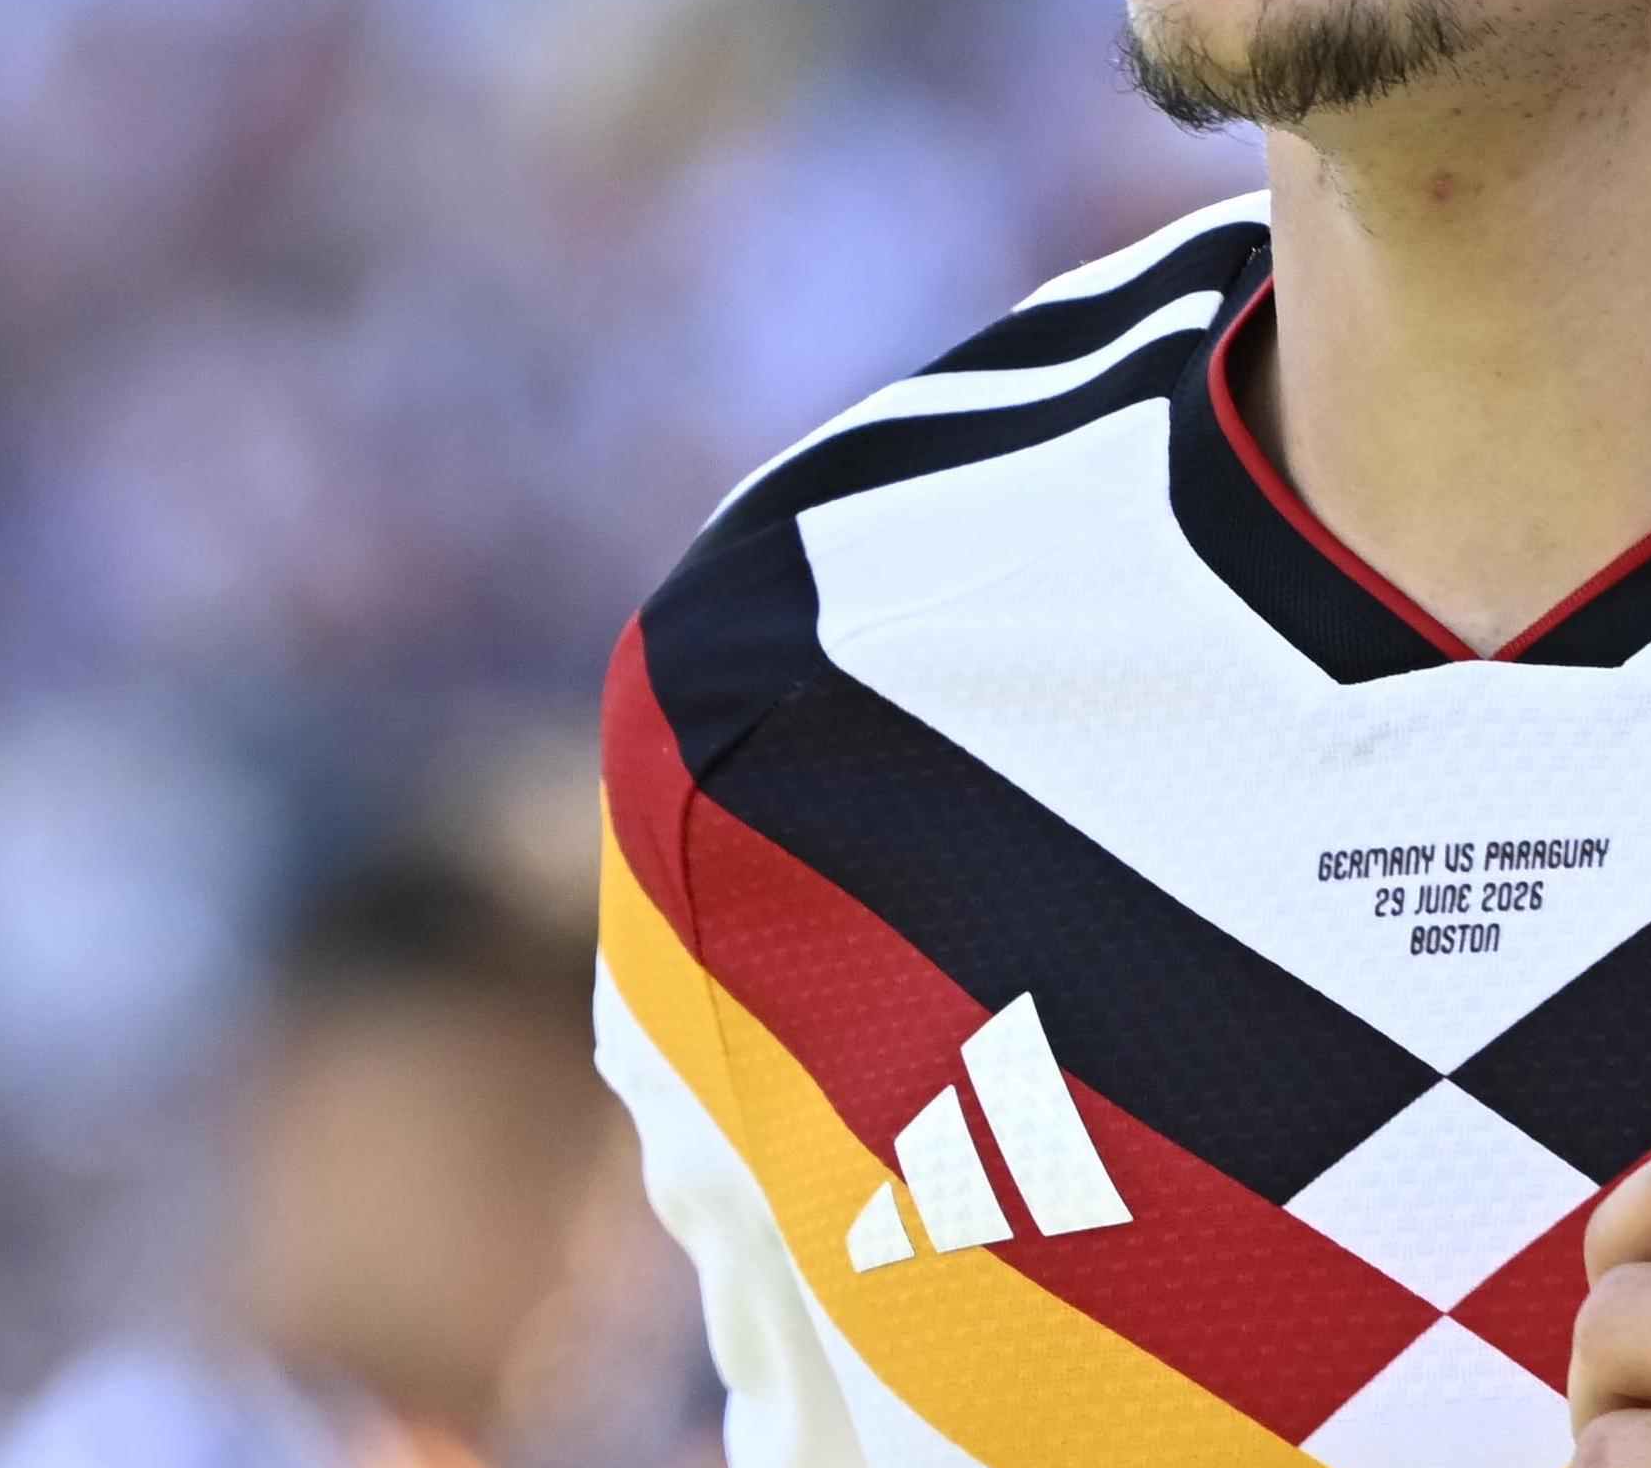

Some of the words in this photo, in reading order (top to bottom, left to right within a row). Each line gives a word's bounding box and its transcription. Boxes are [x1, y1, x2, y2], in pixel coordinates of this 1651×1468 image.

[1317, 845, 1436, 881] GERMANY
[1483, 838, 1610, 872] PARAGUAY
[1373, 888, 1406, 918] 29
[1413, 884, 1472, 915] JUNE
[1480, 881, 1545, 913] 2026
[1409, 923, 1501, 956] BOSTON
